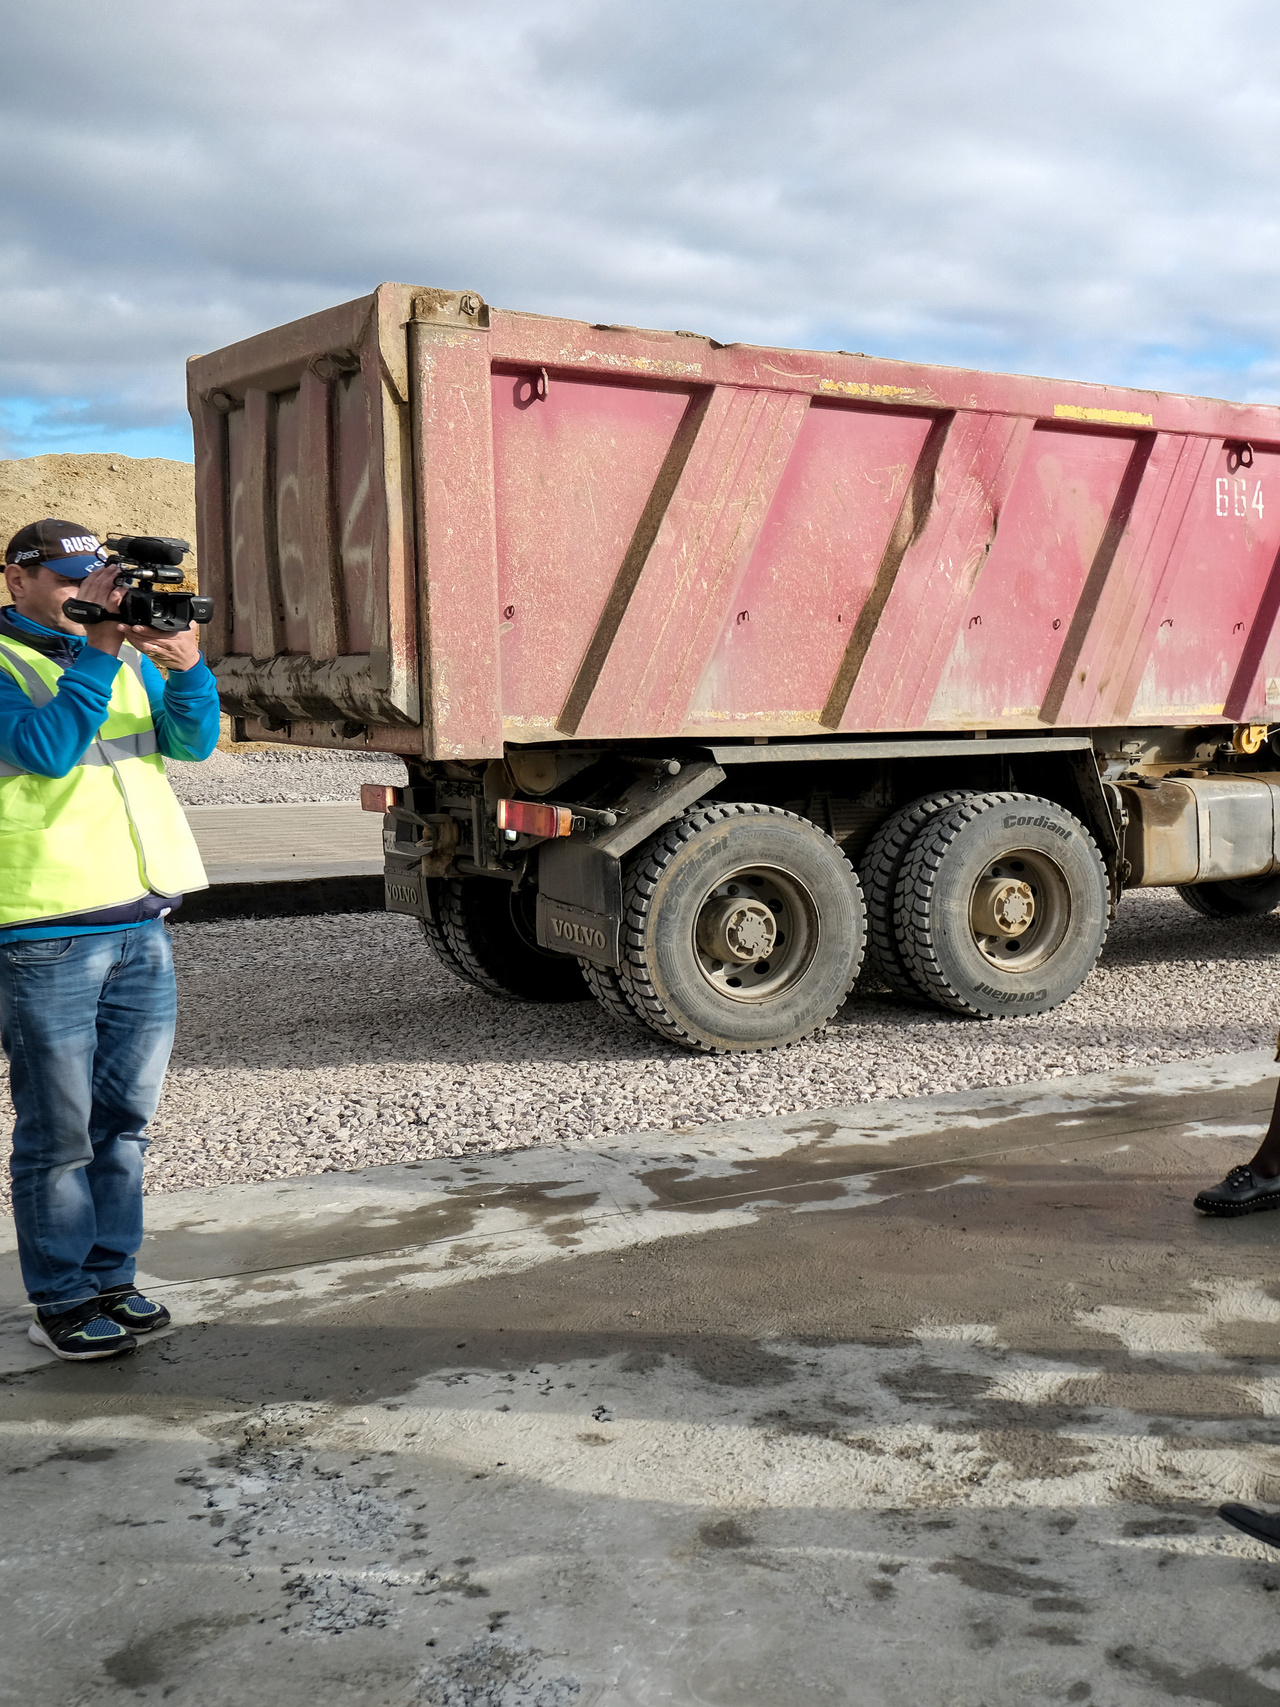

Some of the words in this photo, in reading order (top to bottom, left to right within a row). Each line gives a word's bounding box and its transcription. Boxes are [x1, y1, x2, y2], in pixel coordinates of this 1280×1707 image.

[1215, 477, 1265, 520] 664
[1002, 814, 1073, 841] Cordiant
[662, 833, 730, 917] Cordiant
[385, 882, 418, 905] VOLVO
[550, 917, 607, 950] VOLVO
[972, 981, 1048, 1006] Cordiant
